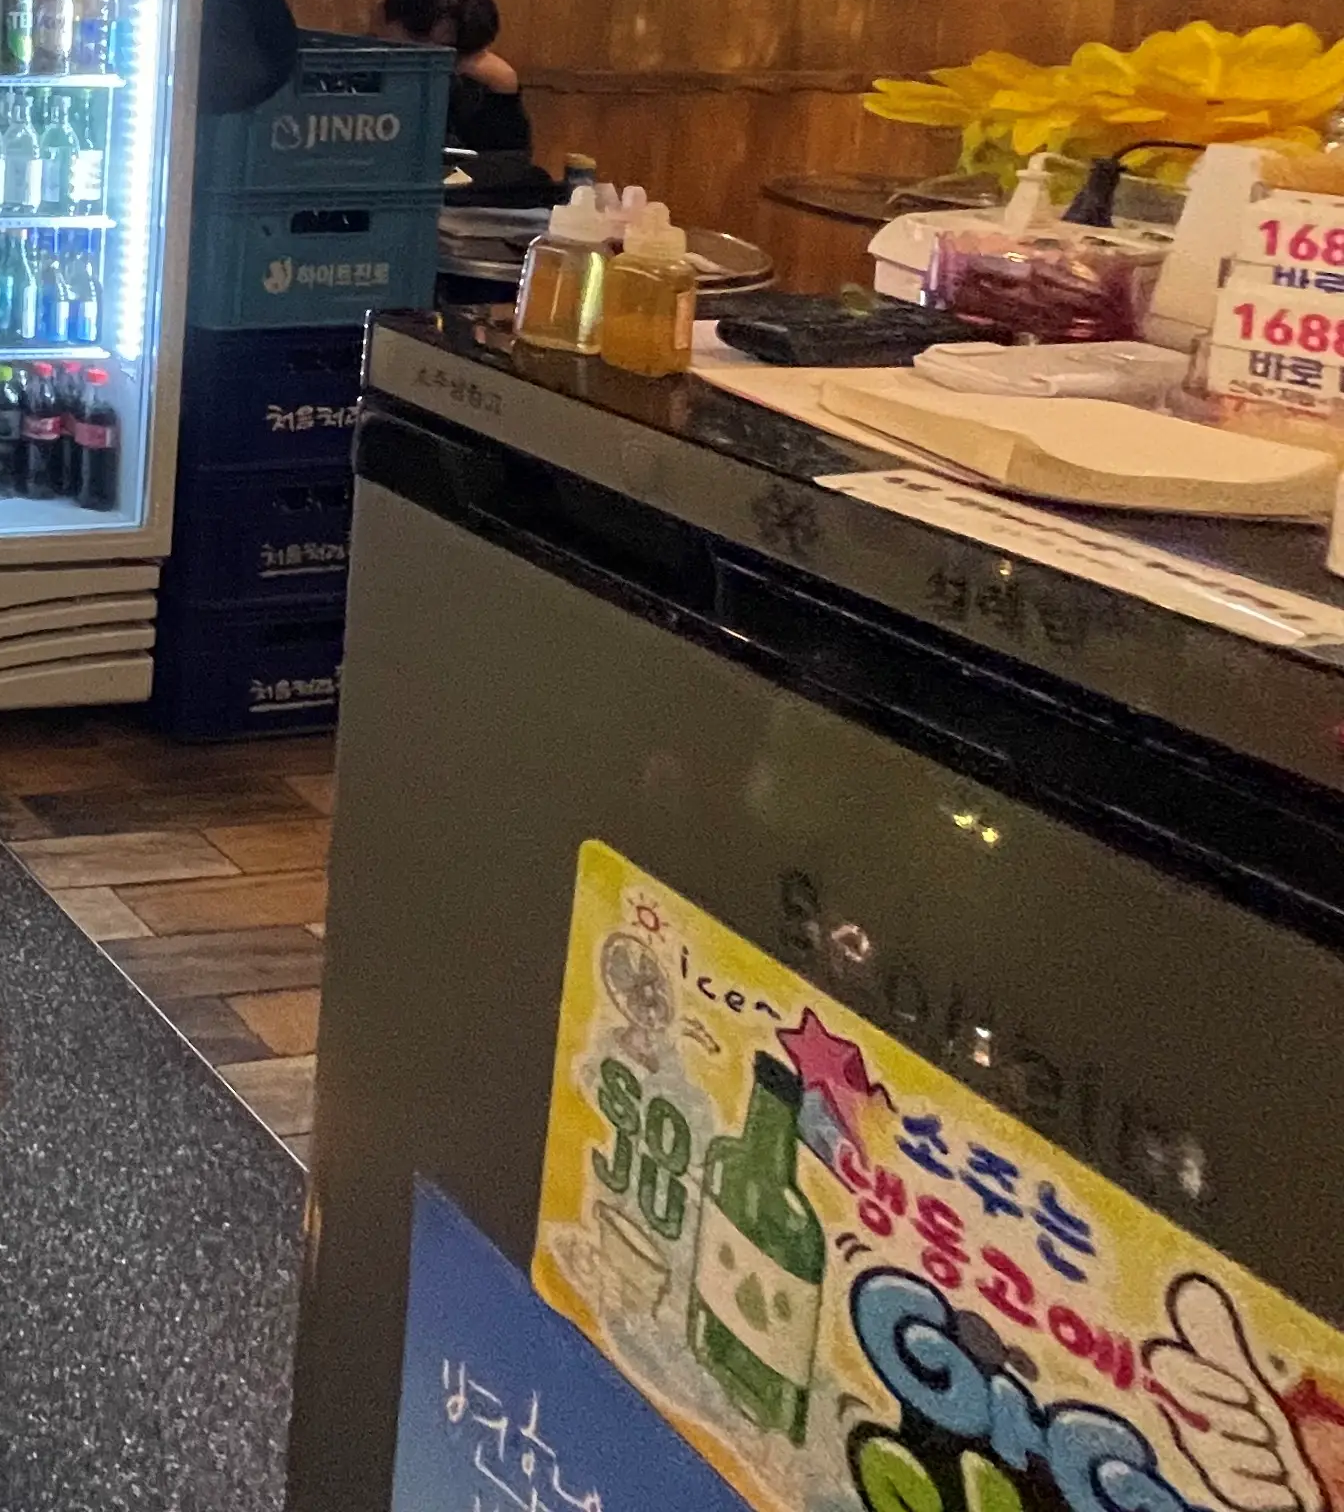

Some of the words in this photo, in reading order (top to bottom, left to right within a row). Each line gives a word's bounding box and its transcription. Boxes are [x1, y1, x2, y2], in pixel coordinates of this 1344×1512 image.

[305, 112, 401, 149] JINRO
[297, 261, 390, 287] 하이트진로
[1249, 350, 1322, 389] 바로
[596, 1057, 692, 1177] SO
[592, 1143, 688, 1242] JU
[895, 1113, 1098, 1284] 소주는
